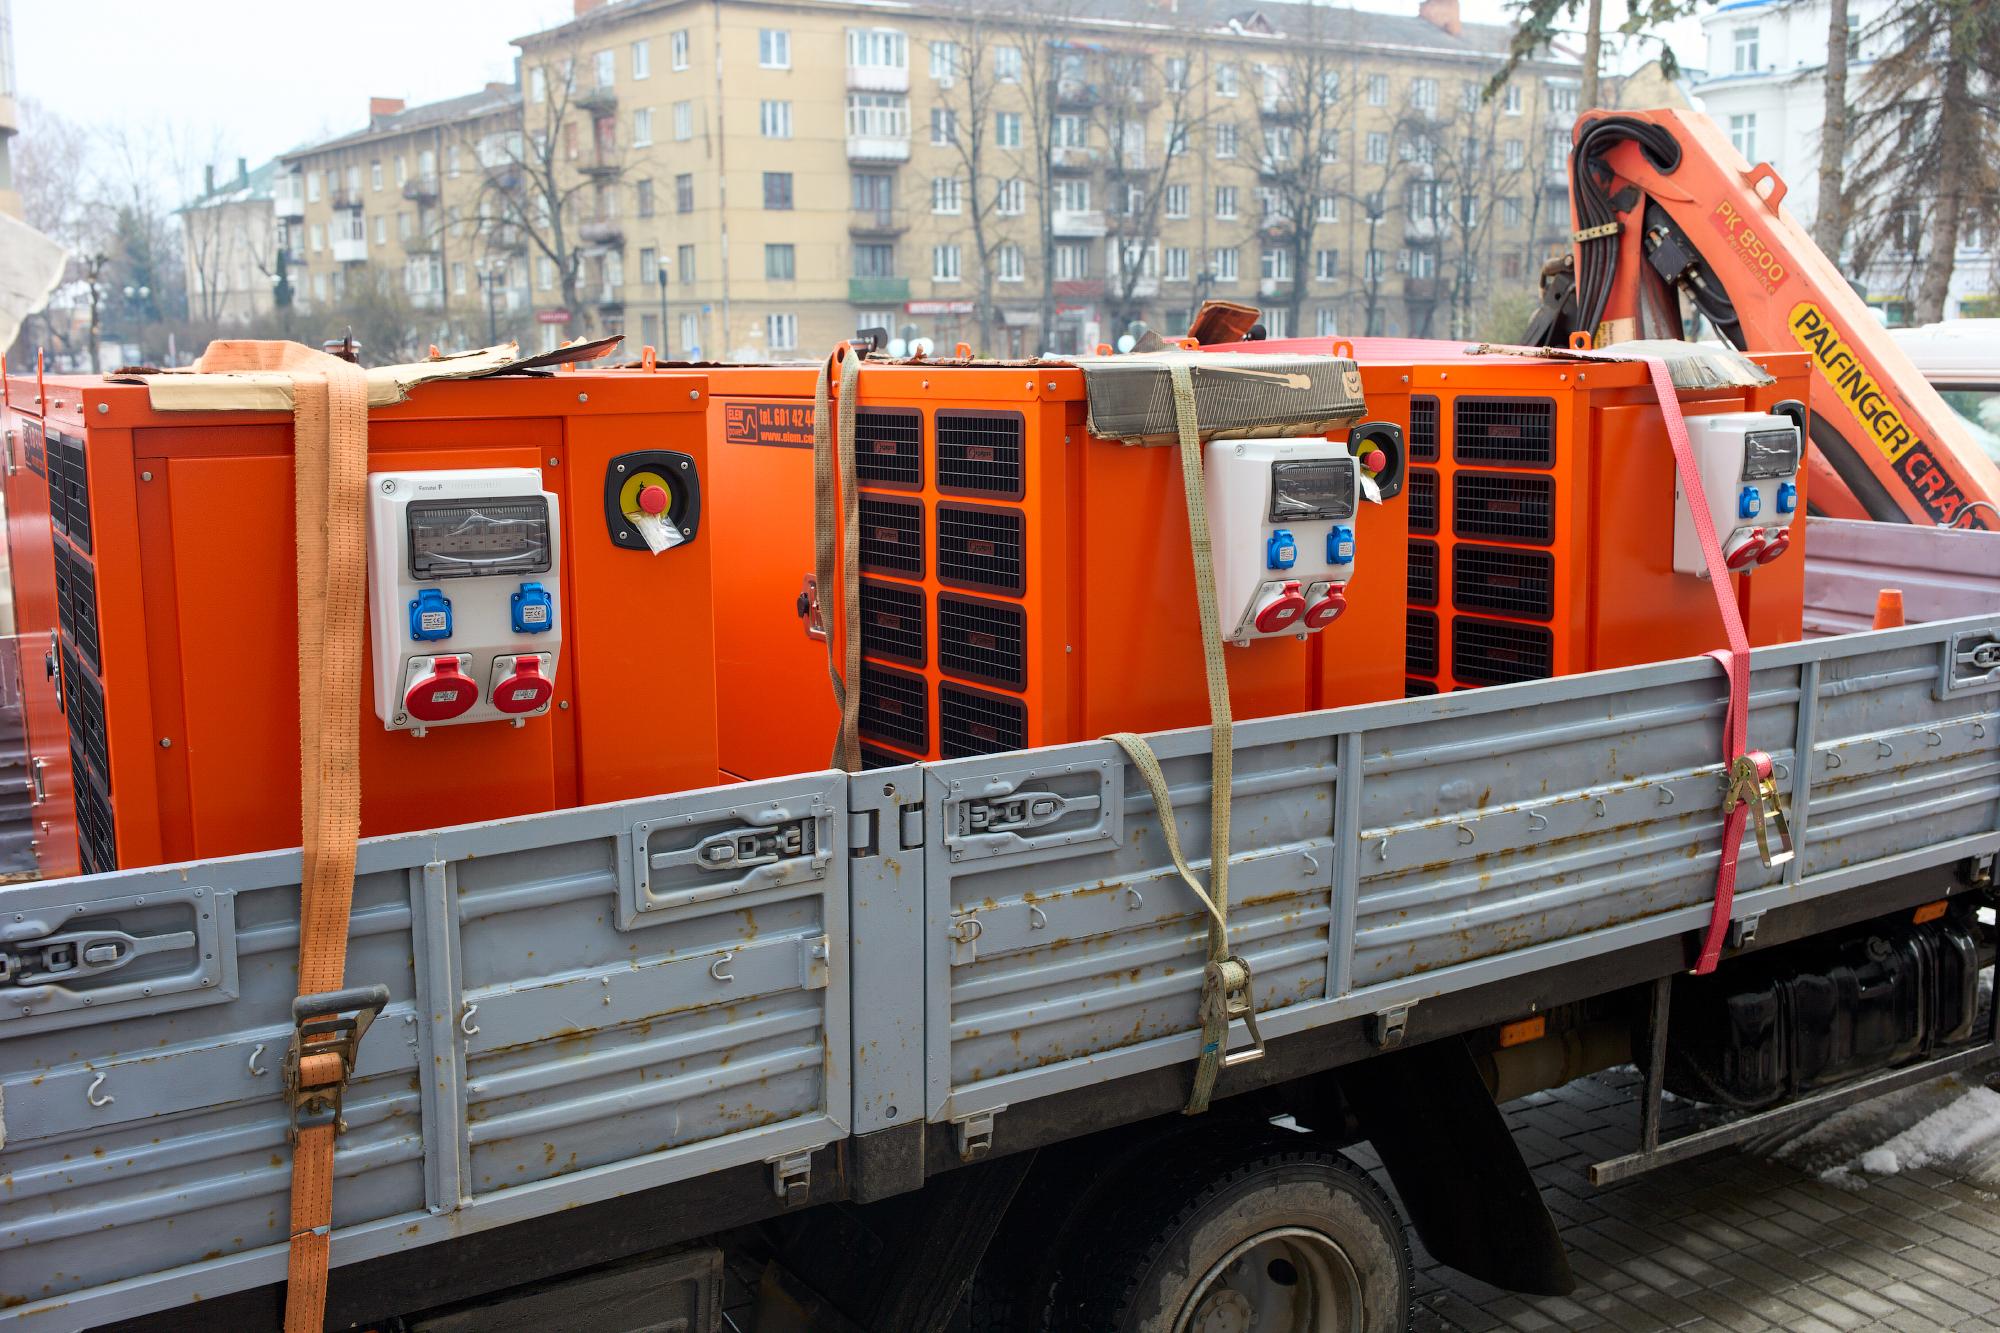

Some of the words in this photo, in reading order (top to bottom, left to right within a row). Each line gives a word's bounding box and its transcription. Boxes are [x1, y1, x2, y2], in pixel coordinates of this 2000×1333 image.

[1715, 200, 1742, 231] PK
[1739, 228, 1784, 281] 8500
[1728, 233, 1776, 294] Performance
[1794, 308, 1910, 453] PALFINGER
[759, 408, 773, 426] tel.
[774, 408, 790, 426] 601
[792, 409, 804, 427] 42
